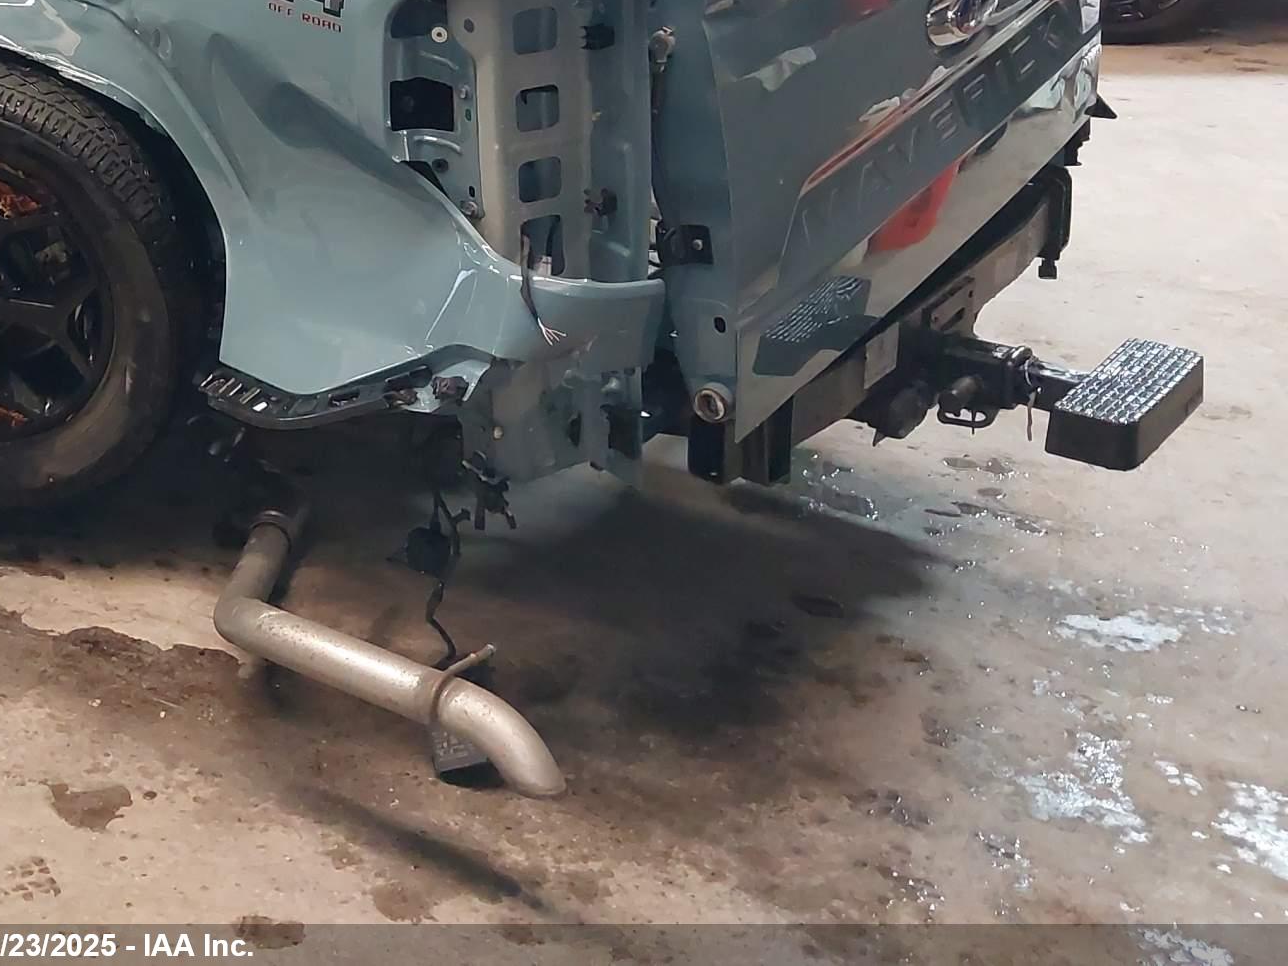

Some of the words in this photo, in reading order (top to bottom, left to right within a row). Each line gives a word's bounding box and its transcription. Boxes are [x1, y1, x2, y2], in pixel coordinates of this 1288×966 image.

[268, 1, 295, 17] OFF
[301, 13, 343, 34] ROAD
[799, 10, 1076, 254] MAVERICK
